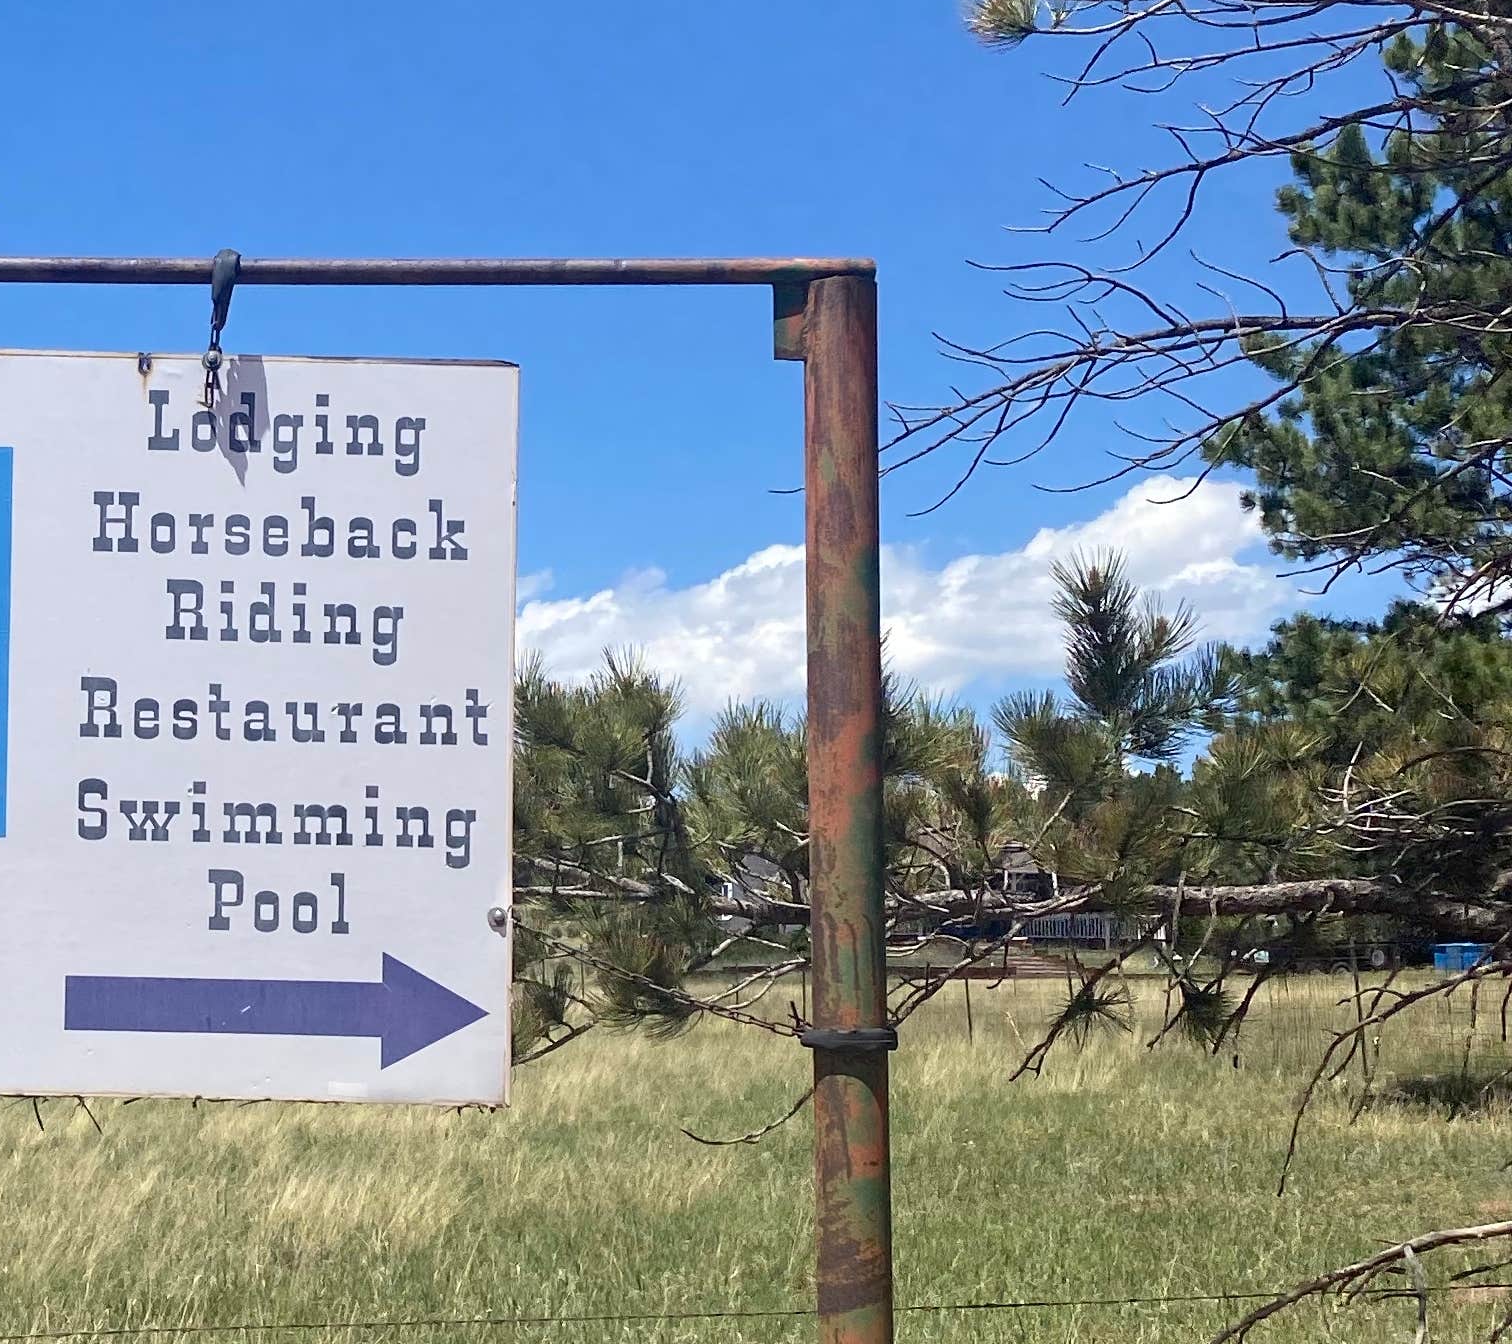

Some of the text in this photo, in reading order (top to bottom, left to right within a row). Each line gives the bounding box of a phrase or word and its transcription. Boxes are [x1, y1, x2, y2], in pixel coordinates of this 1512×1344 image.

[148, 389, 426, 476] Lodging
[92, 491, 468, 560] Horseback
[165, 578, 403, 666] Riding
[79, 676, 488, 746] Restaurant
[77, 778, 477, 869] Swimming
[208, 868, 350, 935] Pool
